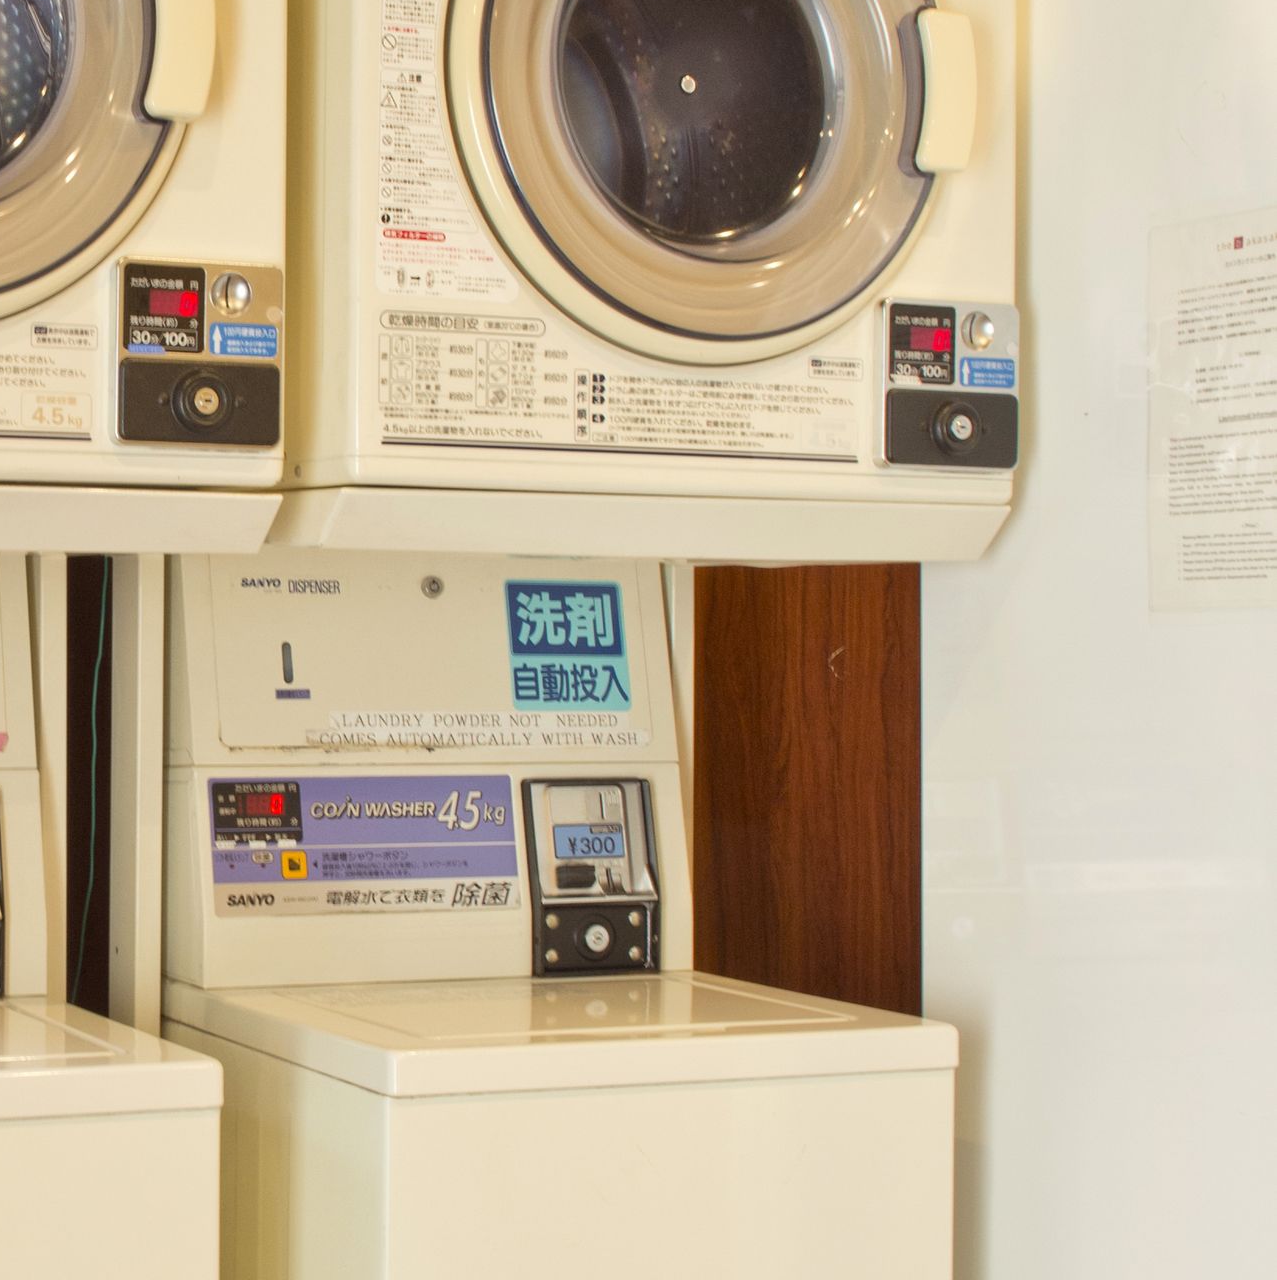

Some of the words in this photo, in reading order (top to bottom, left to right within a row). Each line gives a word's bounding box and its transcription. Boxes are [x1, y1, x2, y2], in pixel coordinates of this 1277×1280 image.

[388, 313, 479, 331] 乾燥時間の目安
[241, 577, 281, 589] SANYO
[288, 579, 341, 594] DISPENSER
[516, 591, 615, 648] 洗剤
[513, 663, 629, 702] 自動投入
[342, 713, 424, 728] LAUNDRY
[433, 714, 501, 728] POWDER
[509, 714, 542, 728] NOT
[556, 714, 619, 728] NEEDED
[319, 732, 377, 746] COMES
[386, 732, 534, 747] AUTOMATICALLY
[542, 732, 584, 746] WITH
[591, 732, 639, 746] WASH
[270, 793, 284, 816] 0
[364, 801, 436, 818] WASHER
[568, 836, 616, 855] ¥300
[227, 893, 275, 907] SANYO
[451, 881, 513, 907] 除菌
